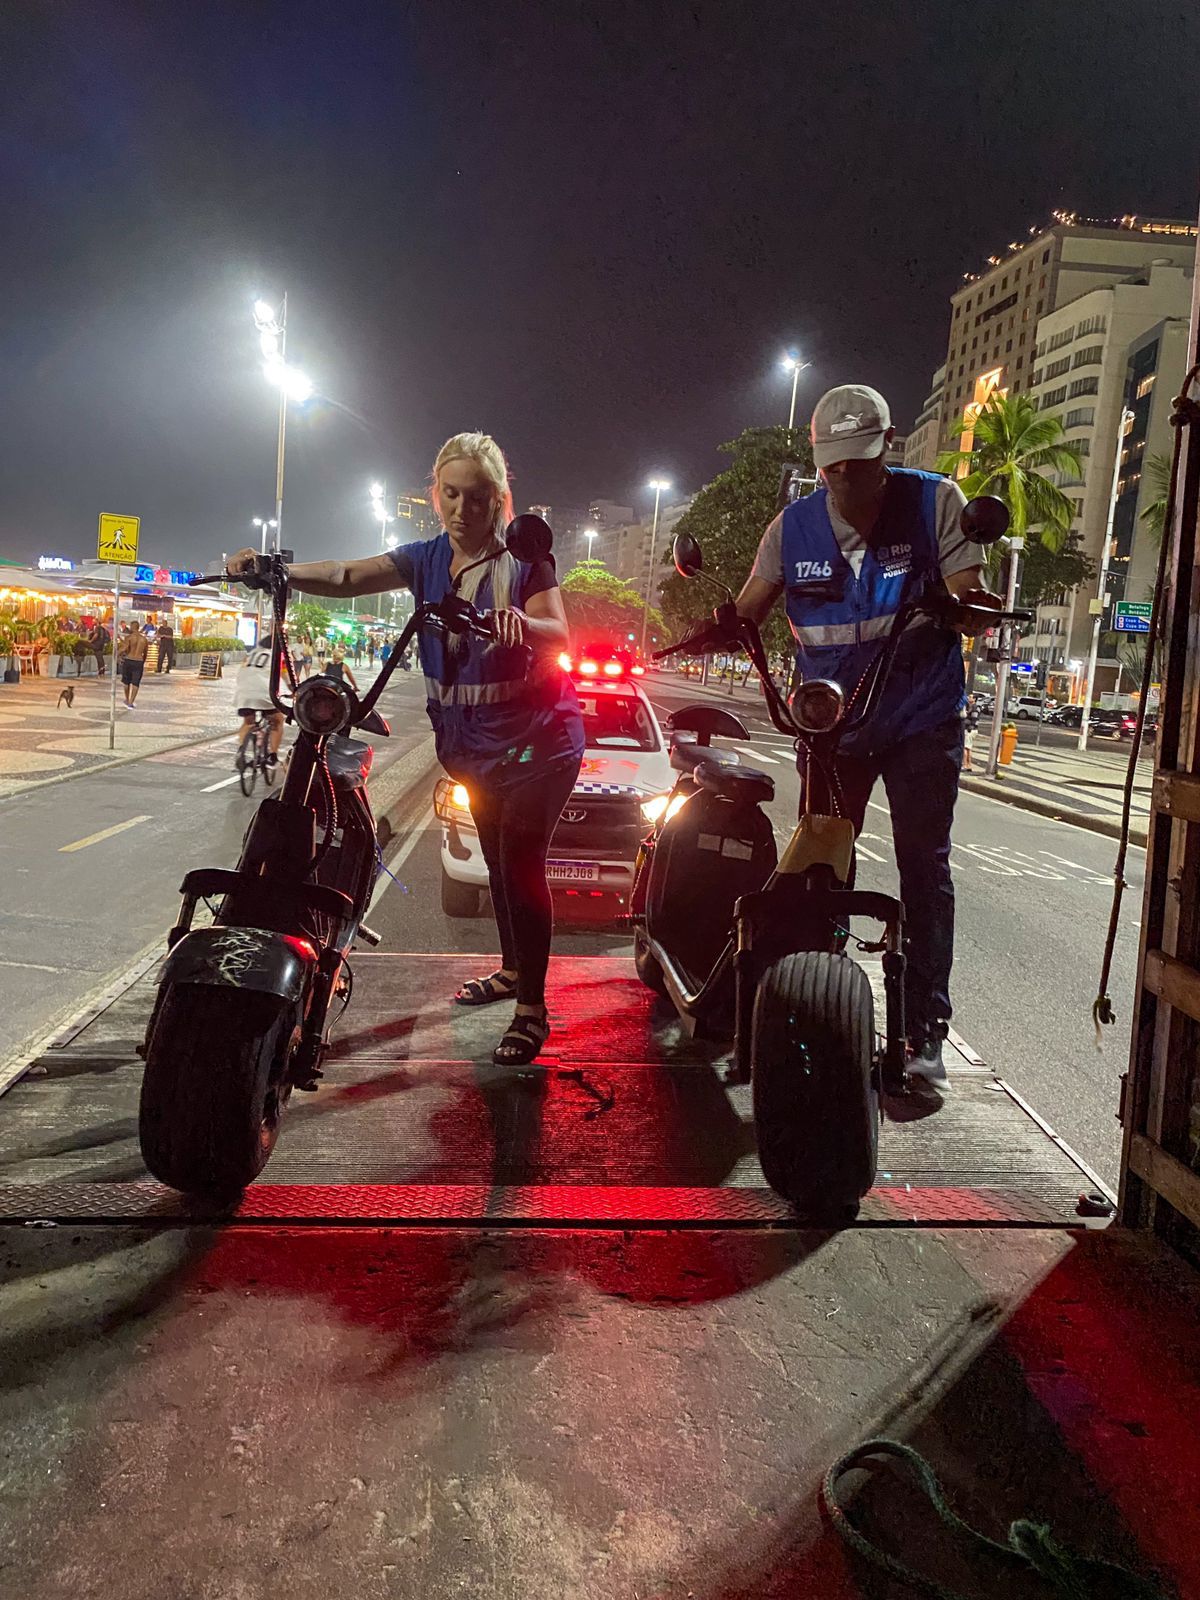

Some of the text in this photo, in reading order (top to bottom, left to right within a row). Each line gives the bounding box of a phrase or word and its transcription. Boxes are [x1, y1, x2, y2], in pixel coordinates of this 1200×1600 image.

[104, 551, 133, 560] ATENÇÃO
[890, 543, 912, 556] Rio
[795, 560, 832, 578] 1746
[247, 652, 270, 668] 10
[546, 866, 593, 879] RHH2J08
